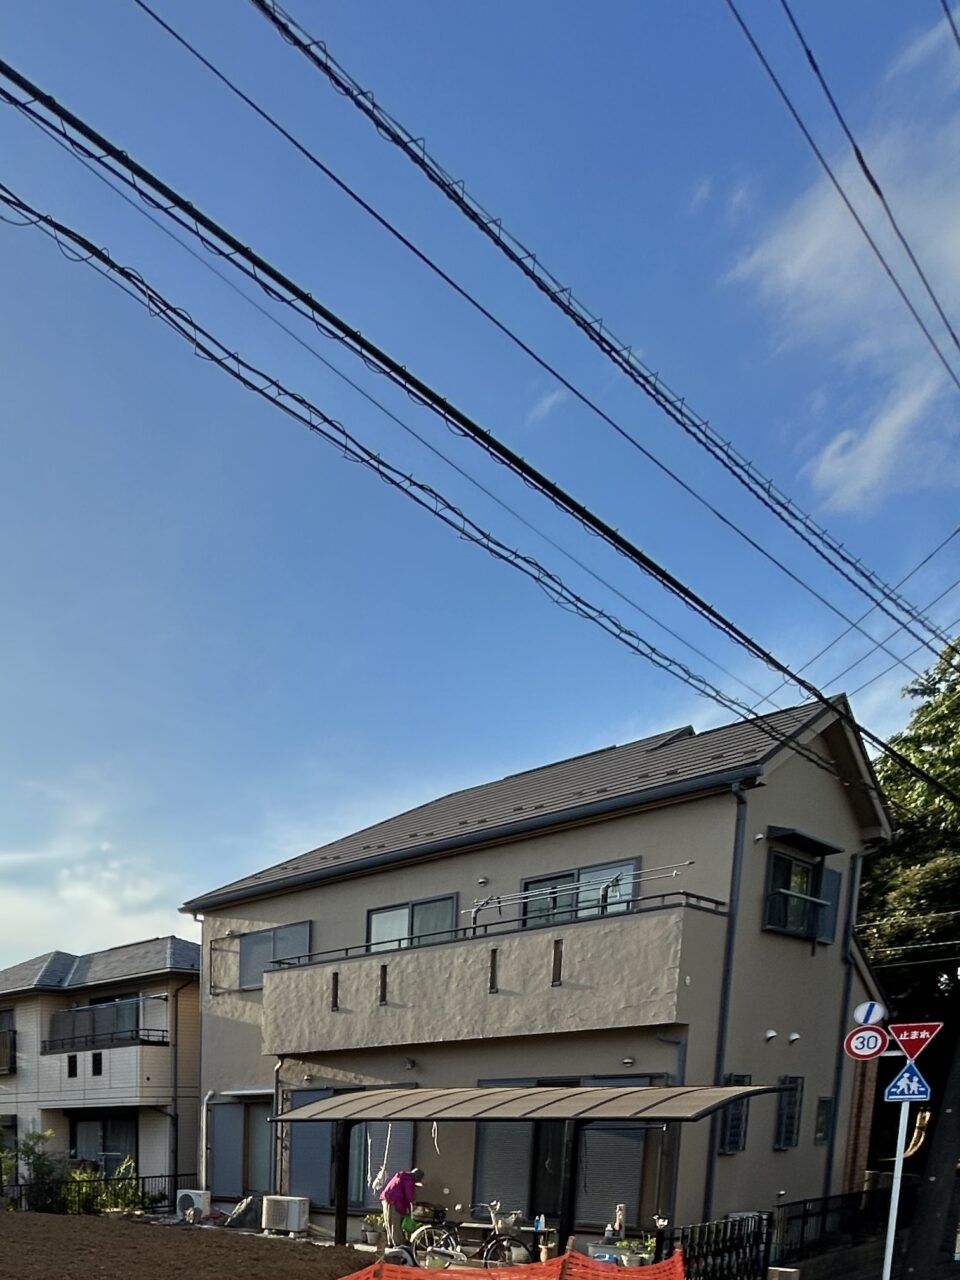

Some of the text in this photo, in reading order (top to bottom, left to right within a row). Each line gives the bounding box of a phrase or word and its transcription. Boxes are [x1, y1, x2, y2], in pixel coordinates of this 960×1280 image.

[898, 1031, 931, 1041] 止まれ
[854, 1035, 878, 1050] 30
